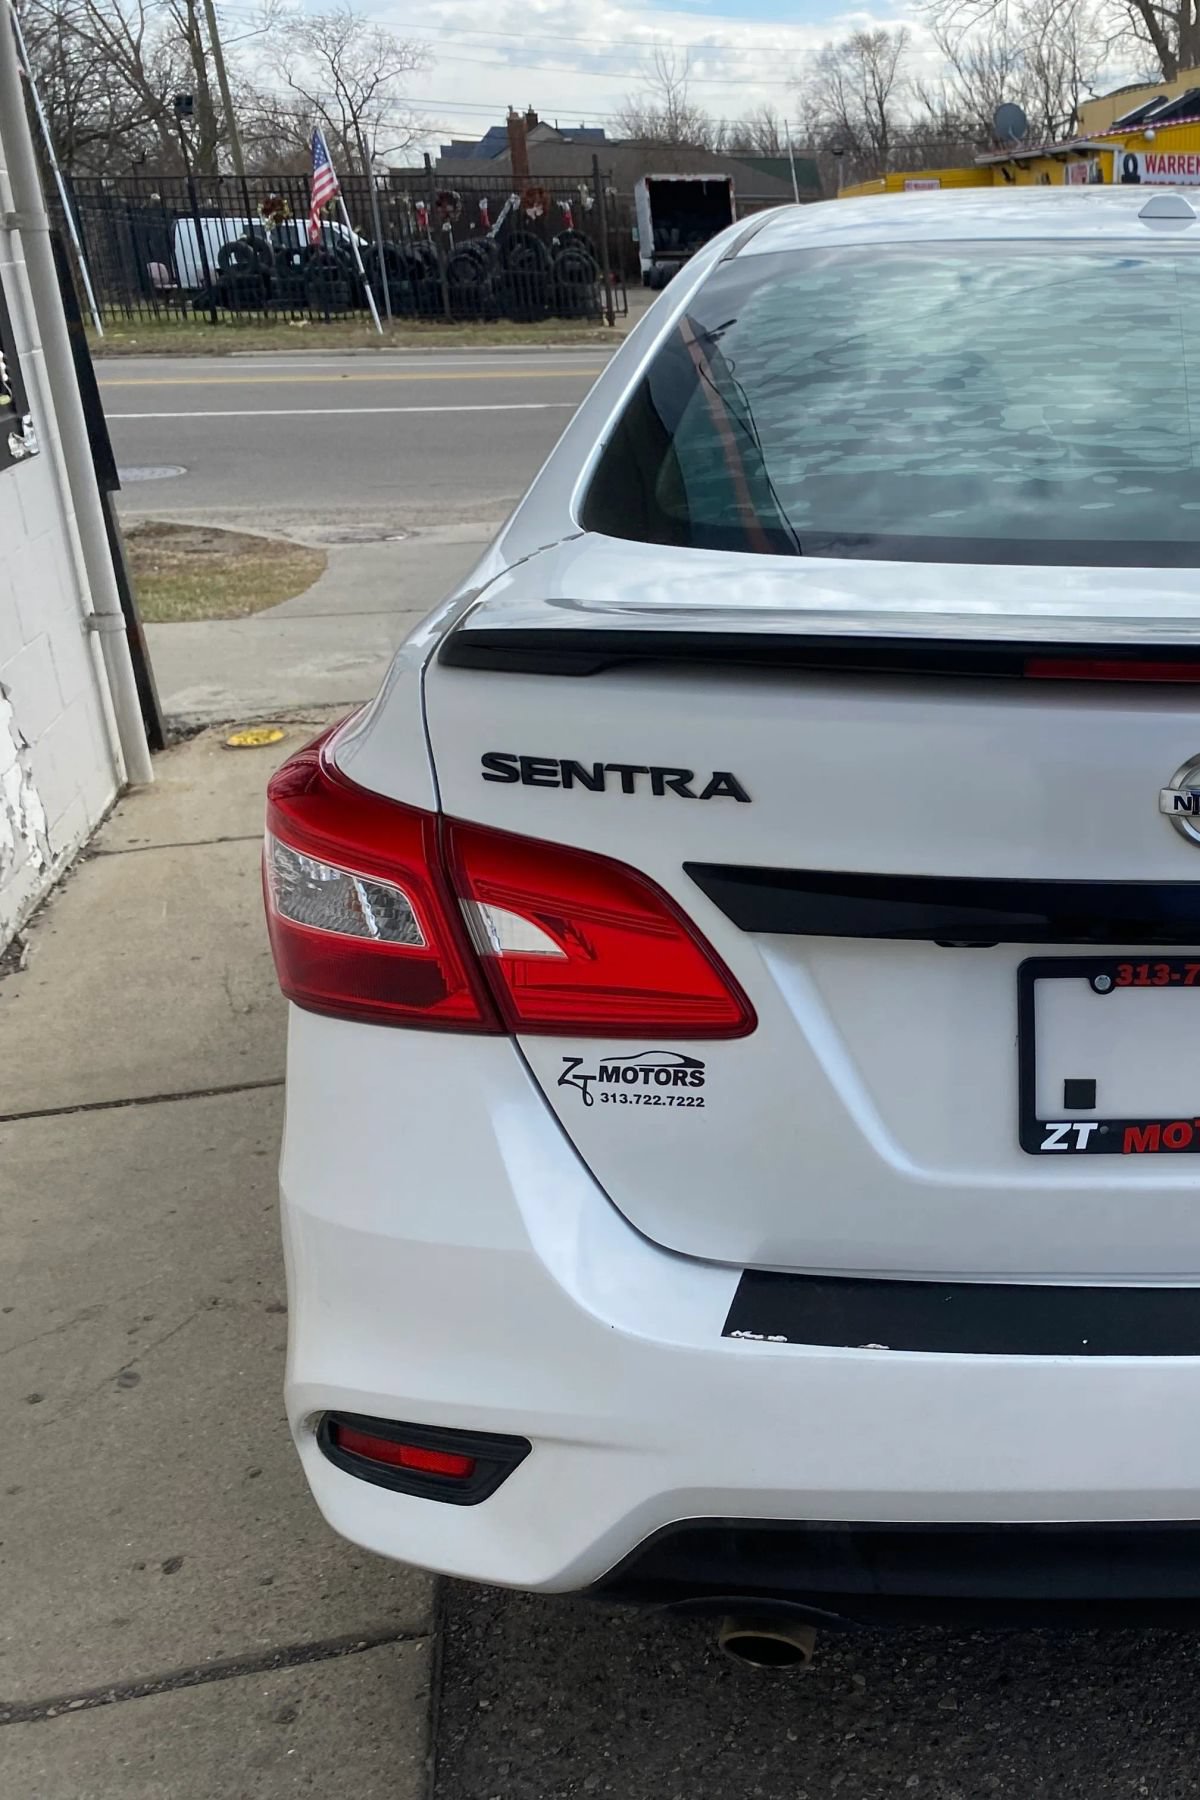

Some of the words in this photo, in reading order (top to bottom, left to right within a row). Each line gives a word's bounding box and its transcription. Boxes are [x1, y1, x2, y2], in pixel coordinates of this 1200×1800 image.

[481, 752, 752, 803] SENTRA
[598, 1065, 706, 1088] MOTORS
[599, 1092, 706, 1108] 313.722.7222
[1040, 1123, 1098, 1150] ZT
